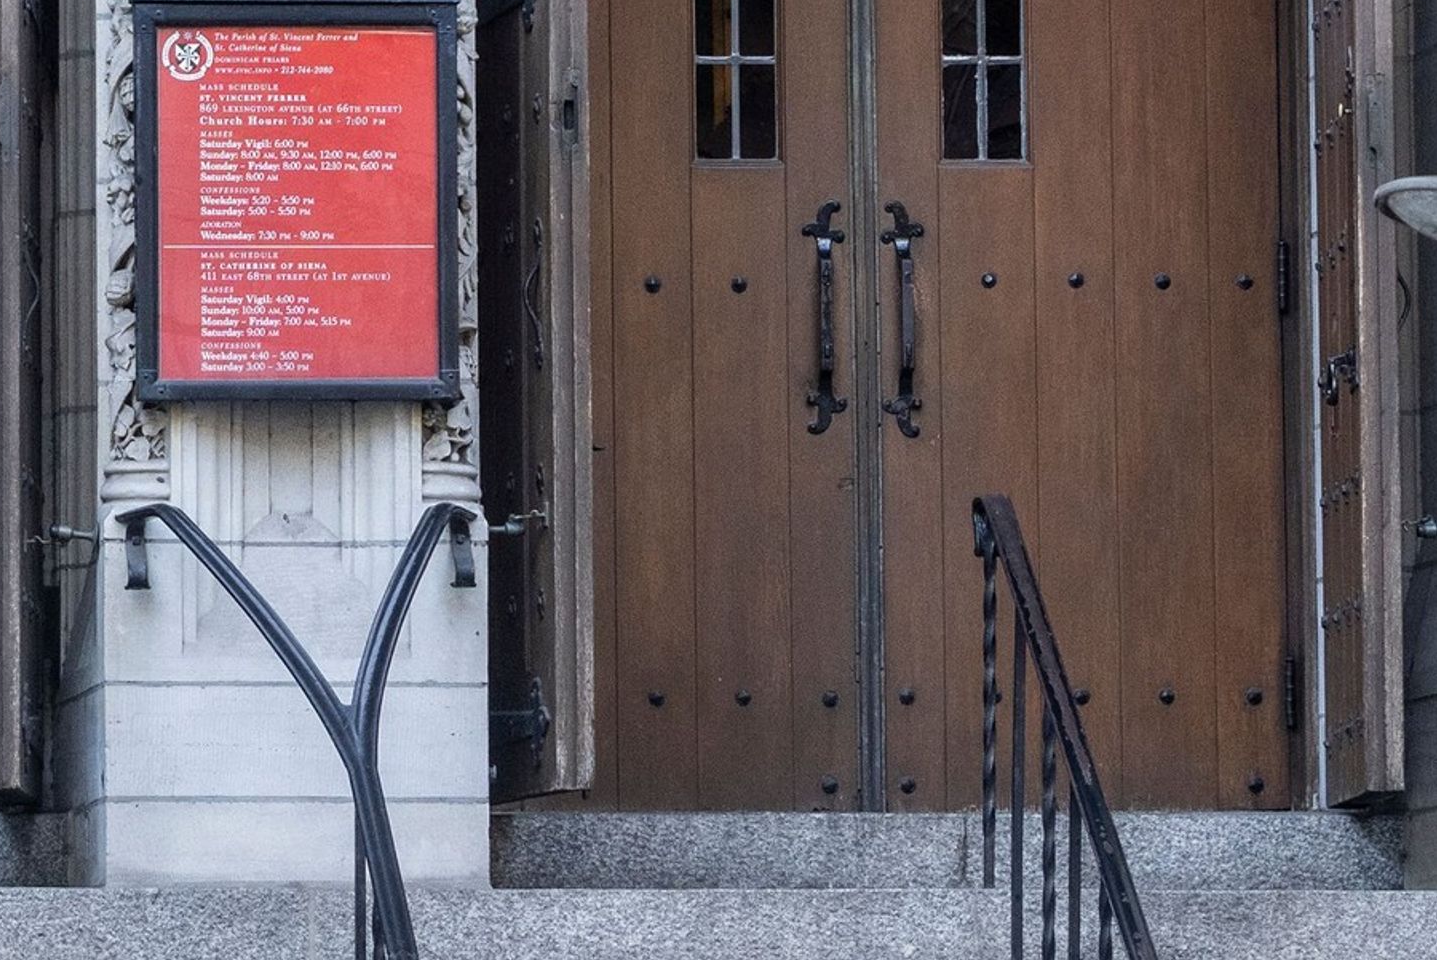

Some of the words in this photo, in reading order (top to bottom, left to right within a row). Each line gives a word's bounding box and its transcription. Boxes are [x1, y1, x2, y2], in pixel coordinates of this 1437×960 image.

[215, 33, 229, 41] The
[231, 33, 257, 41] Parish
[259, 33, 267, 41] of
[269, 33, 281, 41] St.
[284, 33, 314, 41] Vincent
[316, 33, 341, 41] Ferrer
[343, 33, 358, 41] and
[215, 44, 226, 52] St.
[229, 44, 266, 52] Catherine
[269, 44, 277, 52] of
[280, 44, 301, 52] Siena
[199, 104, 218, 113] 869
[317, 104, 332, 113] (AT
[336, 104, 361, 113] 66TH
[365, 104, 402, 113] STREET)
[200, 116, 242, 126] Church
[248, 116, 287, 126] Hours:
[292, 116, 314, 124] 7:30
[346, 116, 368, 124] 7:00
[200, 140, 242, 149] Saturday
[245, 140, 271, 149] Vigil:
[274, 140, 294, 148] 6:00
[200, 151, 237, 160] Sunday:
[200, 162, 238, 171] Monday
[248, 162, 280, 171] Friday:
[282, 162, 302, 170] 8:00
[321, 162, 342, 170] 12:10
[361, 162, 379, 170] 6:00
[200, 173, 243, 182] Saturday:
[245, 173, 264, 181] 8:00
[201, 196, 248, 205] Weekdays:
[251, 196, 270, 204] 5:20
[200, 207, 245, 216] Saturday:
[248, 207, 267, 215] 5:00
[278, 207, 296, 215] 5:50
[201, 232, 256, 240] Wednesday:
[201, 272, 216, 281] 411
[247, 272, 271, 281] 68TH
[313, 272, 327, 281] (AT
[332, 272, 347, 281] 1ST
[351, 272, 390, 281] AVENUE)
[201, 295, 243, 304] Saturday
[246, 295, 273, 304] Vigil:
[276, 295, 294, 303] 4:00
[201, 306, 239, 315] Sunday:
[242, 306, 265, 314] 10:00
[286, 306, 305, 314] 5:00
[201, 318, 239, 326] Monday
[249, 318, 281, 326] Friday:
[201, 328, 244, 337] Saturday:
[247, 328, 265, 336] 9:00
[202, 352, 247, 360] Weekdays
[201, 363, 243, 371] Saturday
